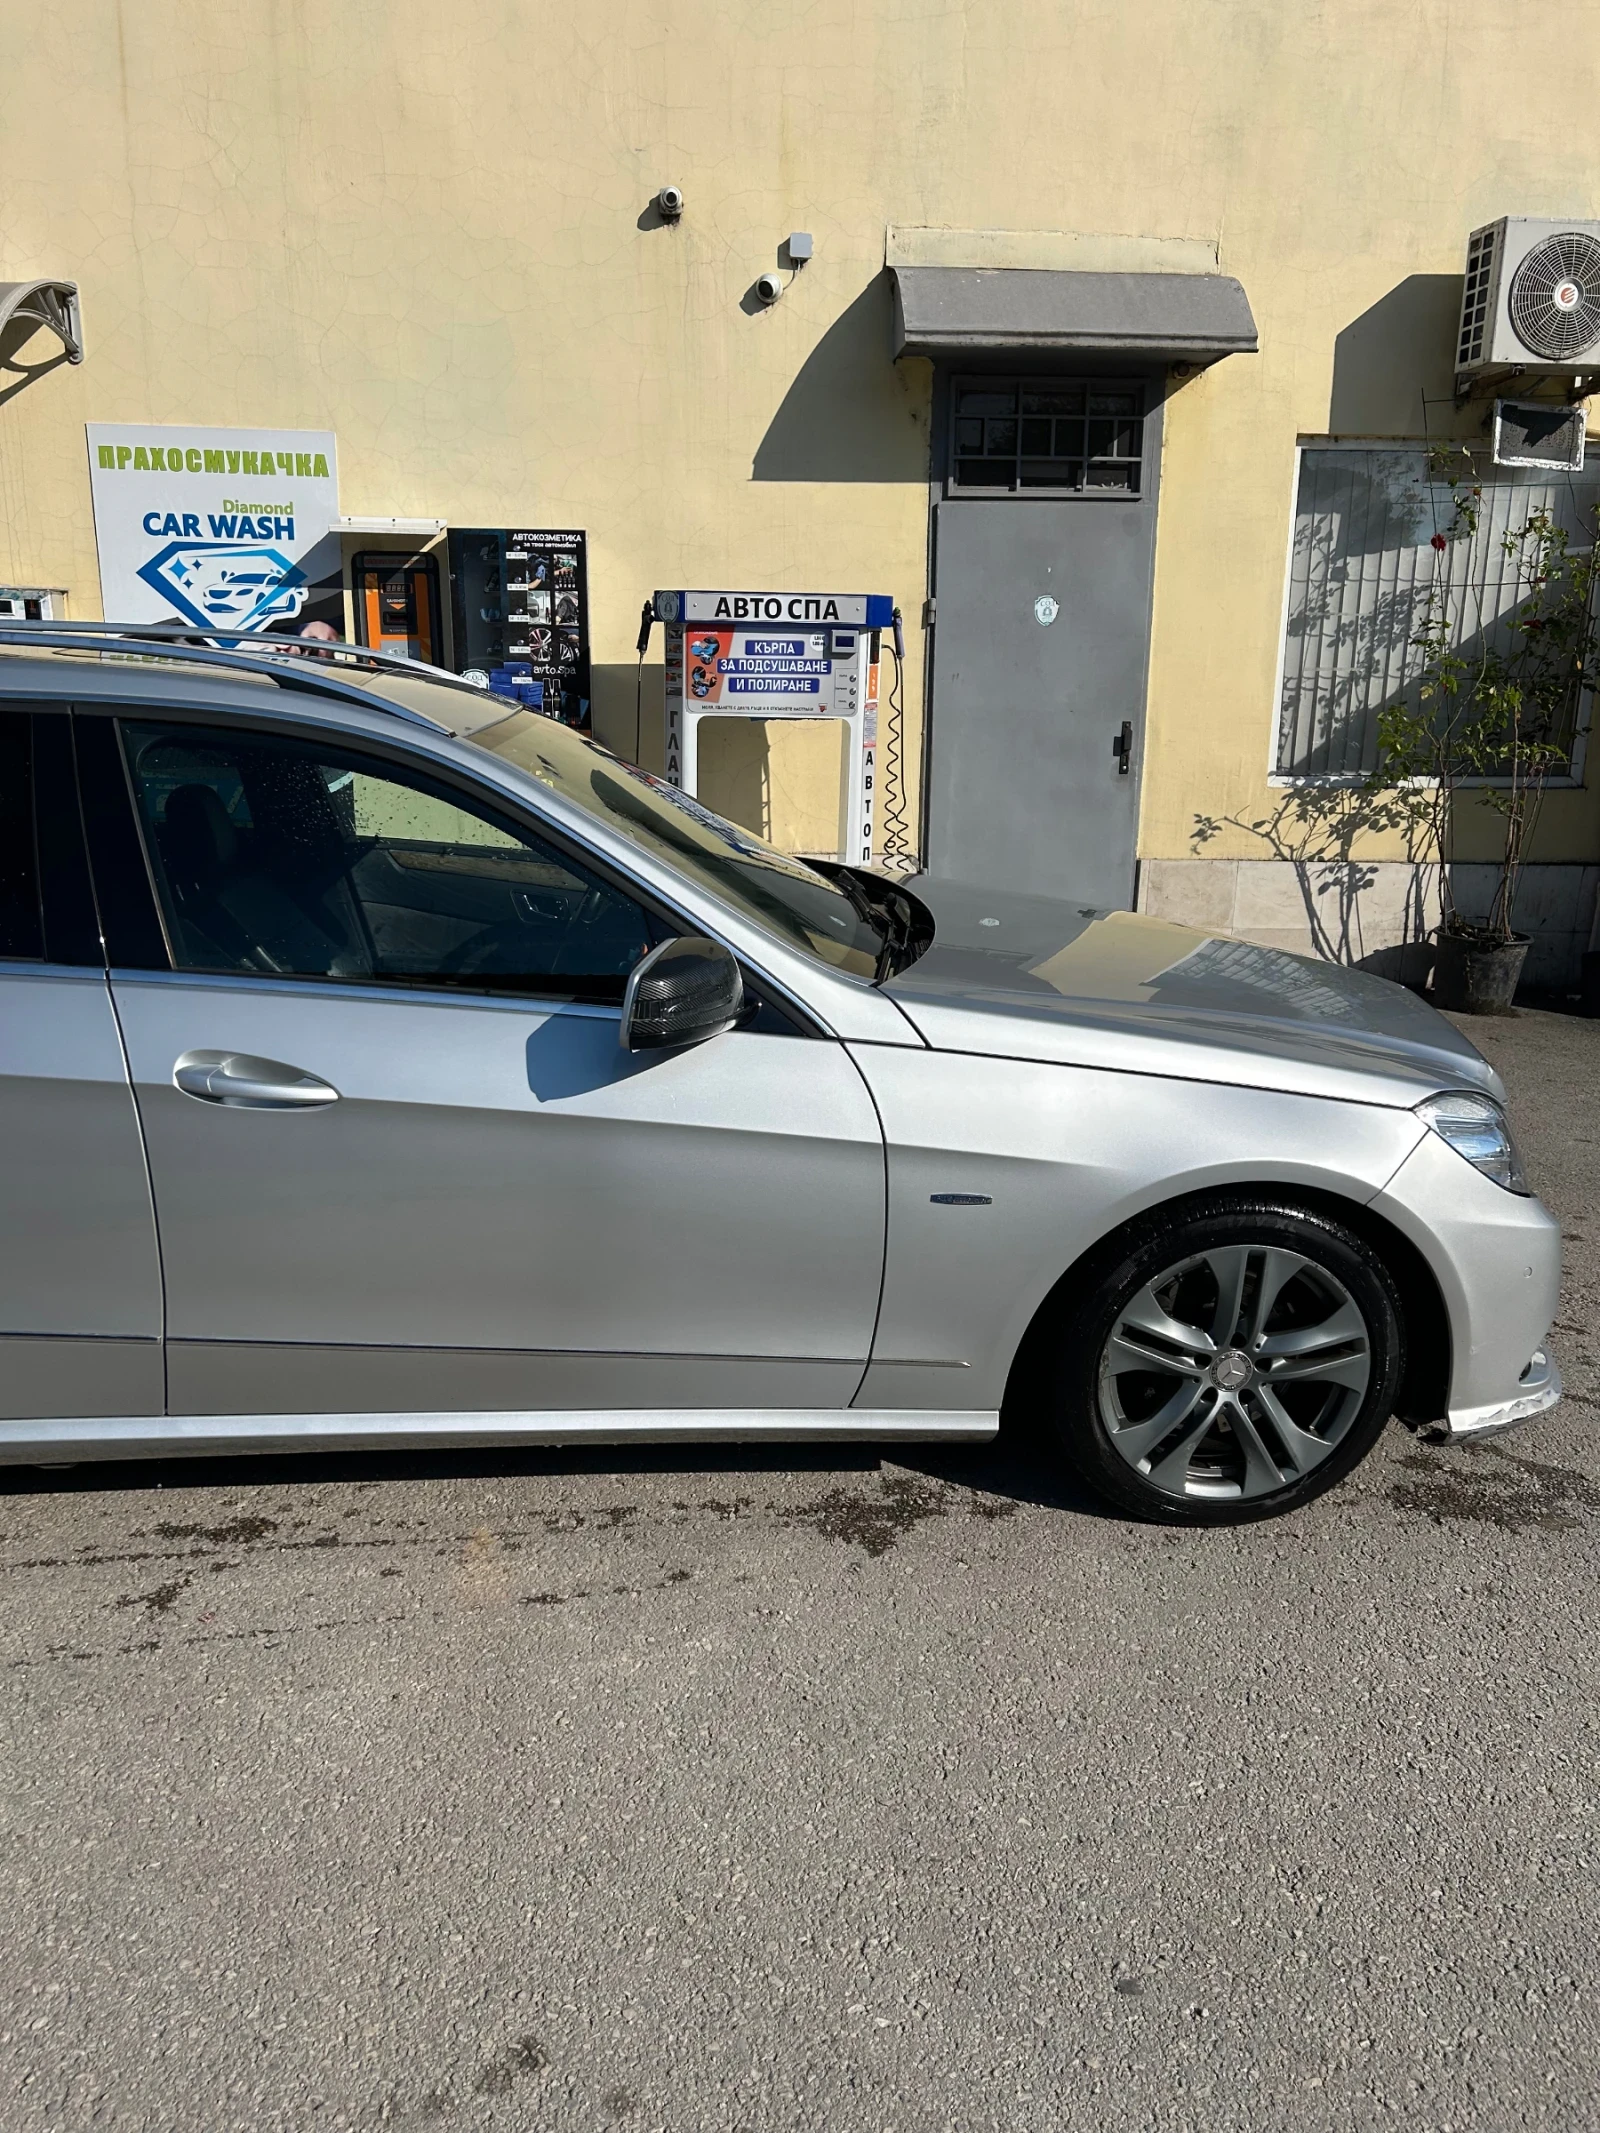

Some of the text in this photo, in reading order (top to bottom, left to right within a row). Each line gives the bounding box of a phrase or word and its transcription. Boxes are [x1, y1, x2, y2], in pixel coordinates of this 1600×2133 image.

[97, 445, 330, 478] ПРАХОСМУКАЧКА
[222, 499, 294, 516] Diamond
[142, 511, 295, 541] CAR WASH
[512, 533, 582, 542] АВТОКОЗМЕТИКА
[714, 596, 840, 621] АВТО СПА
[754, 642, 795, 655] КЪРПА
[720, 659, 828, 673] ЗА ПОДСУШАВАНЕ
[736, 678, 812, 692] И ПОЛИРАНЕ
